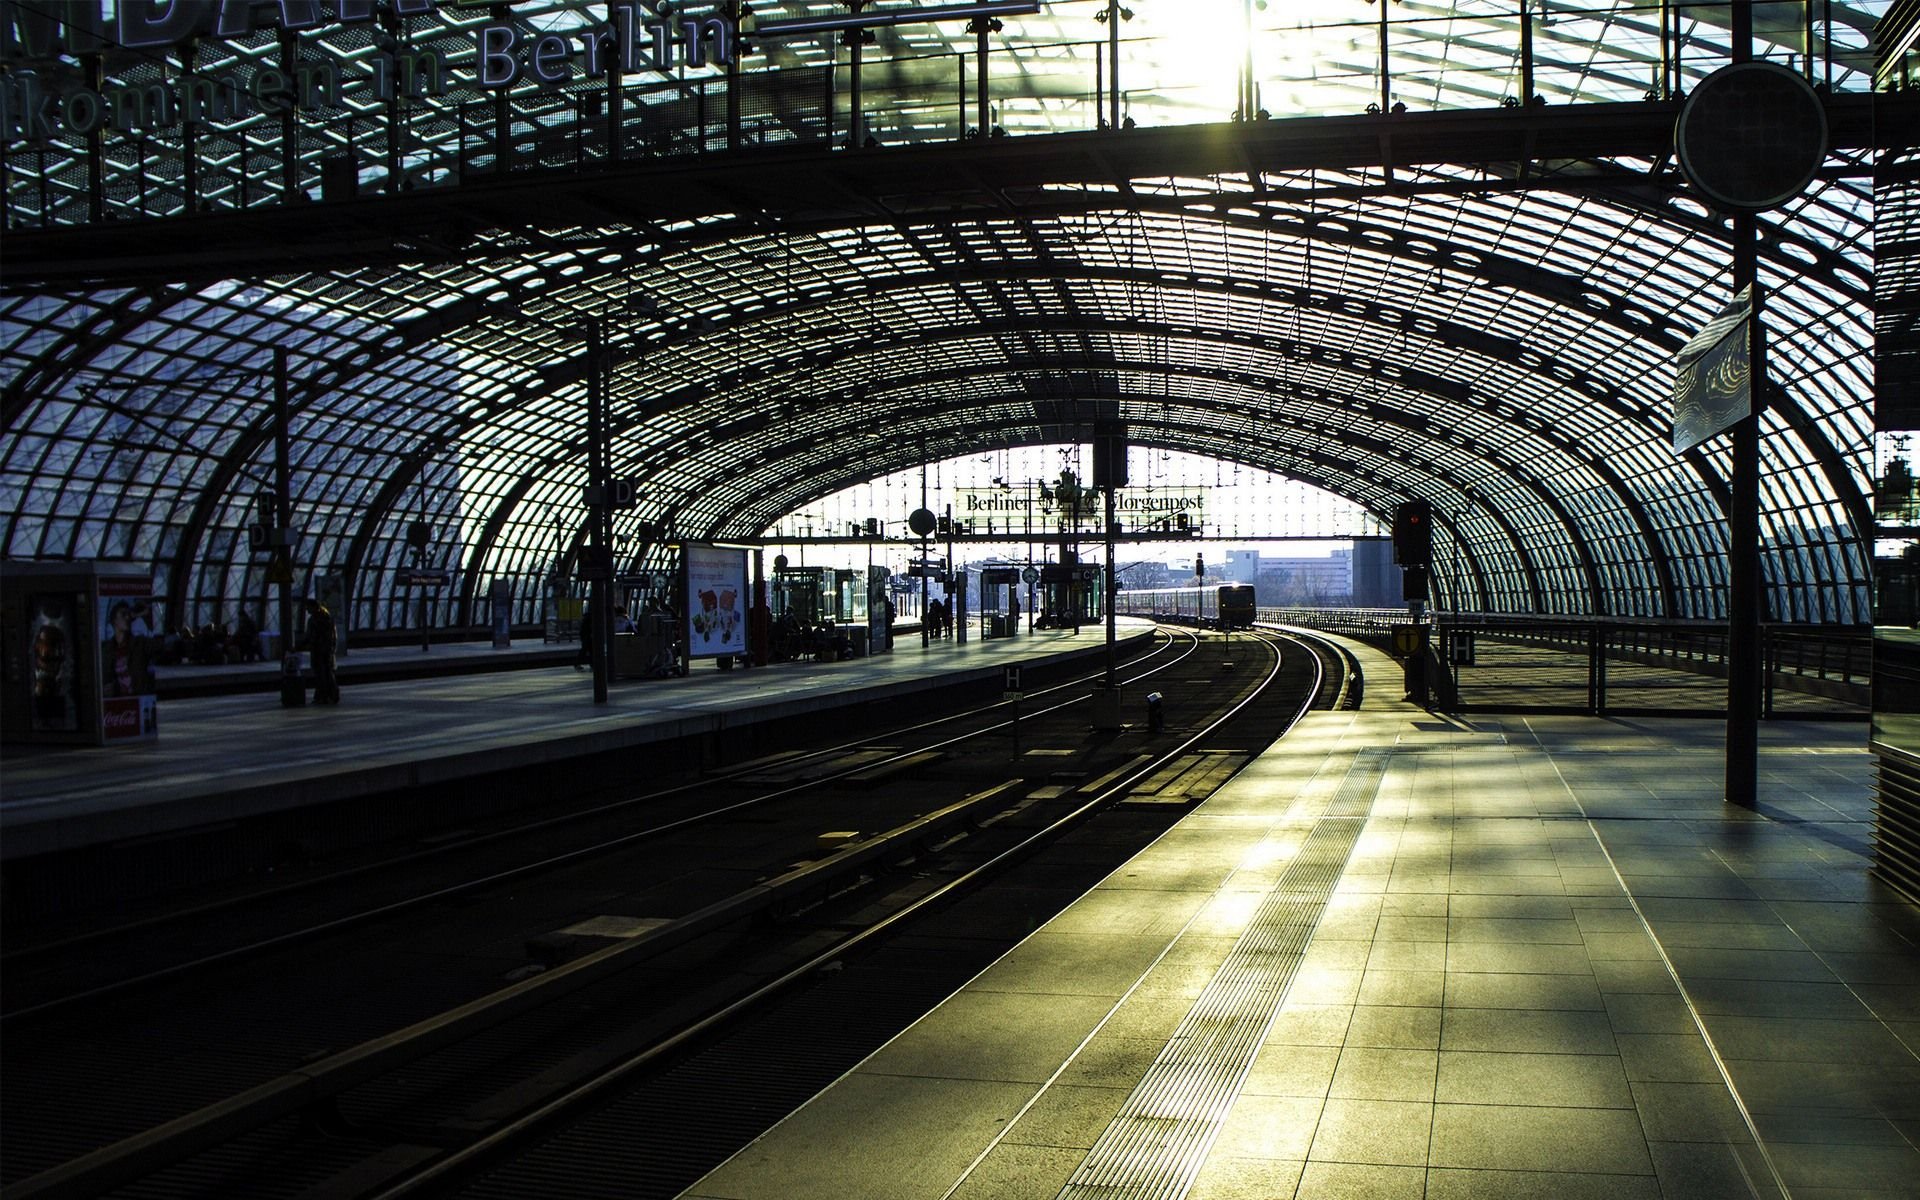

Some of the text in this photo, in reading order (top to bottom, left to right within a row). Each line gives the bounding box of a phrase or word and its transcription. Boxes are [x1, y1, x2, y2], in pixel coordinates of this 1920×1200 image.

[479, 0, 736, 91] Berlin
[615, 481, 632, 503] D
[966, 493, 1028, 511] Berliner
[1453, 635, 1471, 661] H
[1006, 668, 1020, 689] H
